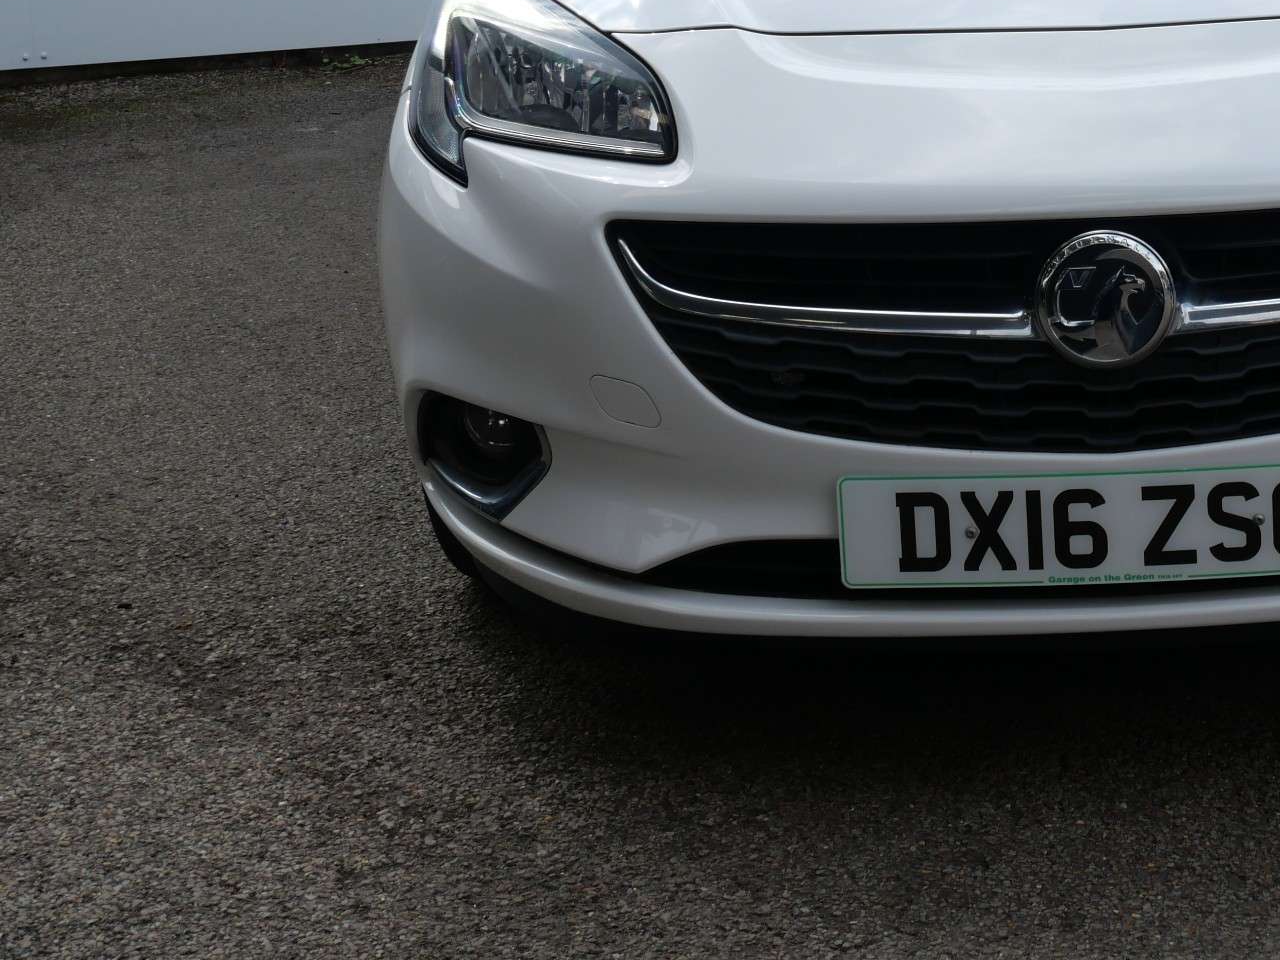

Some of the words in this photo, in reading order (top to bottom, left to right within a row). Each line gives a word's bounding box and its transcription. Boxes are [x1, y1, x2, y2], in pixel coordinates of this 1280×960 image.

[894, 488, 1109, 573] DX16
[1048, 575, 1086, 584] Garage
[1104, 574, 1121, 582] the
[1124, 573, 1155, 581] Green
